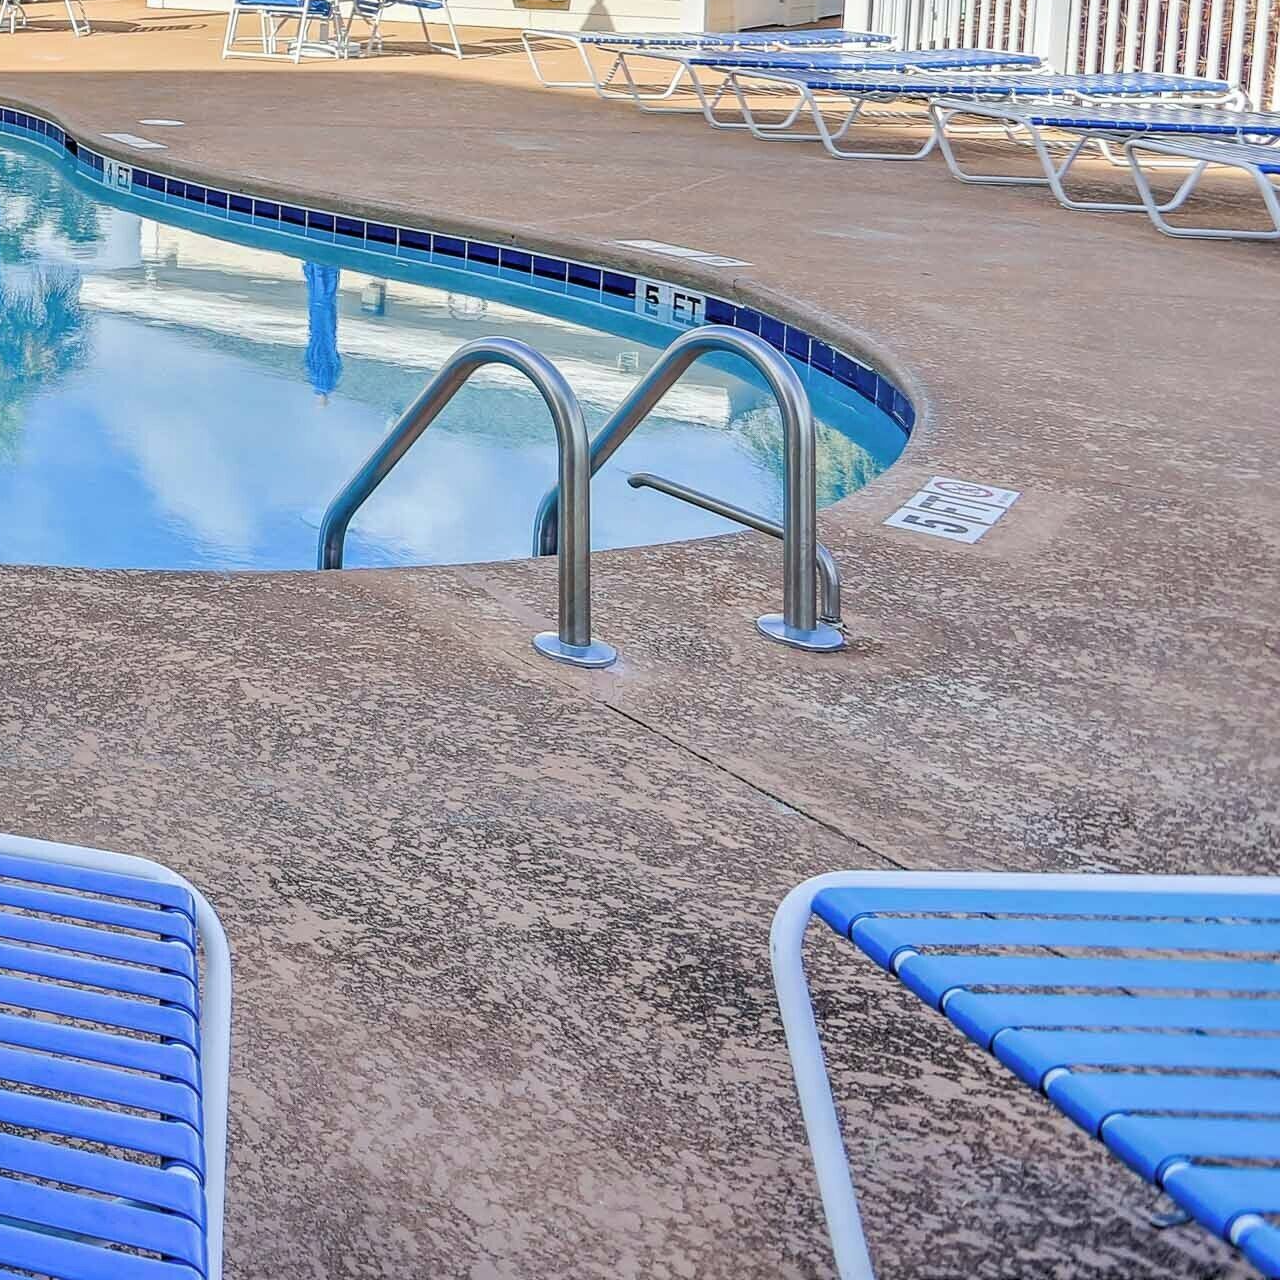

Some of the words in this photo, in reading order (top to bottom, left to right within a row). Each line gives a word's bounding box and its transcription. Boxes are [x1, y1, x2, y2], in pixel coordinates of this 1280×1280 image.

[673, 292, 702, 318] FT
[918, 495, 991, 521] FT
[902, 514, 969, 534] 5
